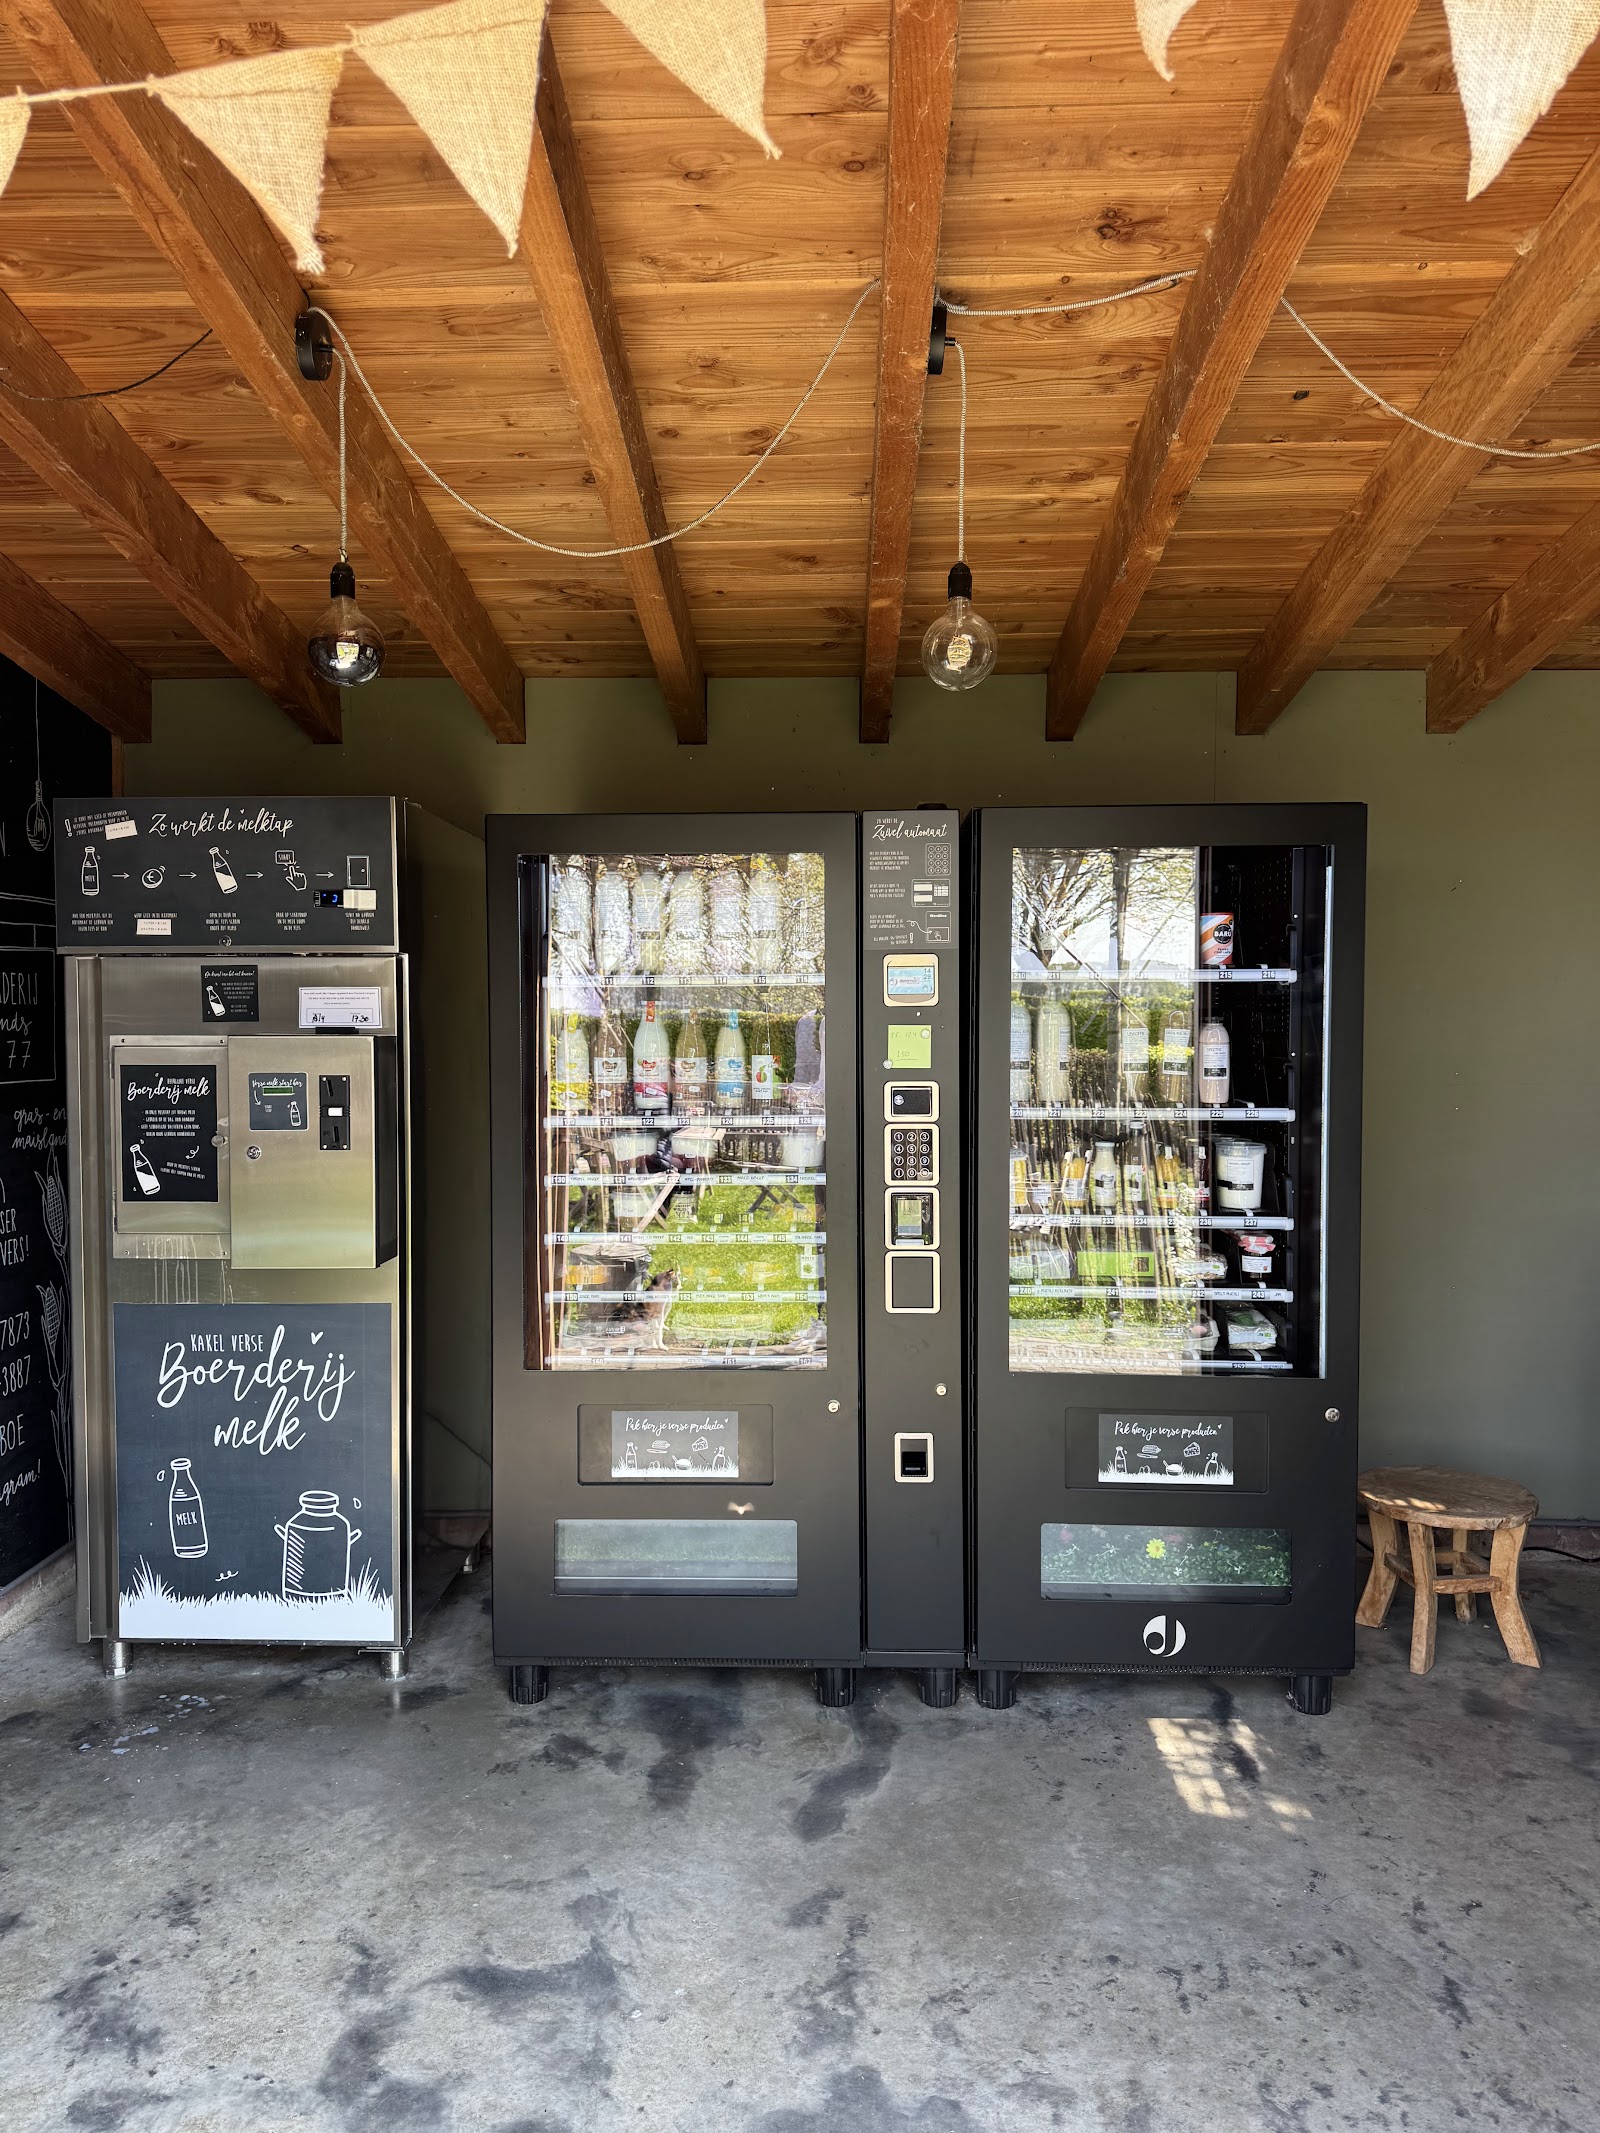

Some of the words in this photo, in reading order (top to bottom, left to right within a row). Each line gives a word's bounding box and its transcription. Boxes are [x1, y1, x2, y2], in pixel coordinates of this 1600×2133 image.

[149, 813, 167, 837] Zo
[171, 811, 215, 836] werkt
[218, 808, 235, 831] de
[238, 808, 294, 837] melktap
[904, 823, 948, 839] automaat
[1219, 971, 1232, 979] 215
[1262, 971, 1275, 979] 216
[642, 977, 655, 985] 112
[754, 976, 767, 984] 115
[0, 971, 38, 1006] DERIJ
[127, 1077, 182, 1104] Boerderij
[184, 1076, 210, 1097] melk
[1092, 1110, 1105, 1118] 222
[1134, 1110, 1147, 1118] 223
[1174, 1110, 1187, 1118] 224
[1210, 1110, 1224, 1118] 225
[1246, 1110, 1259, 1118] 226
[601, 1118, 613, 1126] 121
[642, 1118, 654, 1126] 122
[678, 1118, 690, 1126] 123
[721, 1117, 733, 1125] 124
[553, 1176, 567, 1184] 130
[614, 1176, 626, 1184] 131
[719, 1175, 732, 1183] 133
[786, 1175, 799, 1183] 134
[1102, 1217, 1115, 1225] 233
[1134, 1218, 1147, 1226] 234
[1168, 1218, 1181, 1226] 23
[1200, 1218, 1212, 1226] 236
[1244, 1218, 1258, 1227] 237
[620, 1234, 632, 1242] 141
[669, 1234, 682, 1242] 142
[702, 1234, 714, 1242] 143
[736, 1234, 748, 1242] 144
[773, 1233, 786, 1242] 145
[0, 1235, 29, 1266] VERS!
[1107, 1288, 1119, 1296] 241
[1252, 1290, 1265, 1299] 243
[565, 1292, 578, 1301] 150
[623, 1292, 636, 1301] 151
[0, 1311, 30, 1350] 7873
[190, 1333, 225, 1352] KAKEL
[231, 1333, 264, 1352] VERSE
[157, 1324, 355, 1422] Boerderij
[214, 1385, 306, 1455] melk
[626, 1416, 641, 1431] Pak
[642, 1419, 657, 1433] hier
[655, 1421, 667, 1436] je
[668, 1422, 689, 1432] verse
[689, 1416, 725, 1433] producten
[1115, 1420, 1130, 1435] Pak
[1131, 1422, 1147, 1437] hier
[1146, 1426, 1157, 1441] je
[1158, 1426, 1181, 1437] verse
[1181, 1422, 1217, 1438] producten
[175, 1512, 198, 1526] MELK
